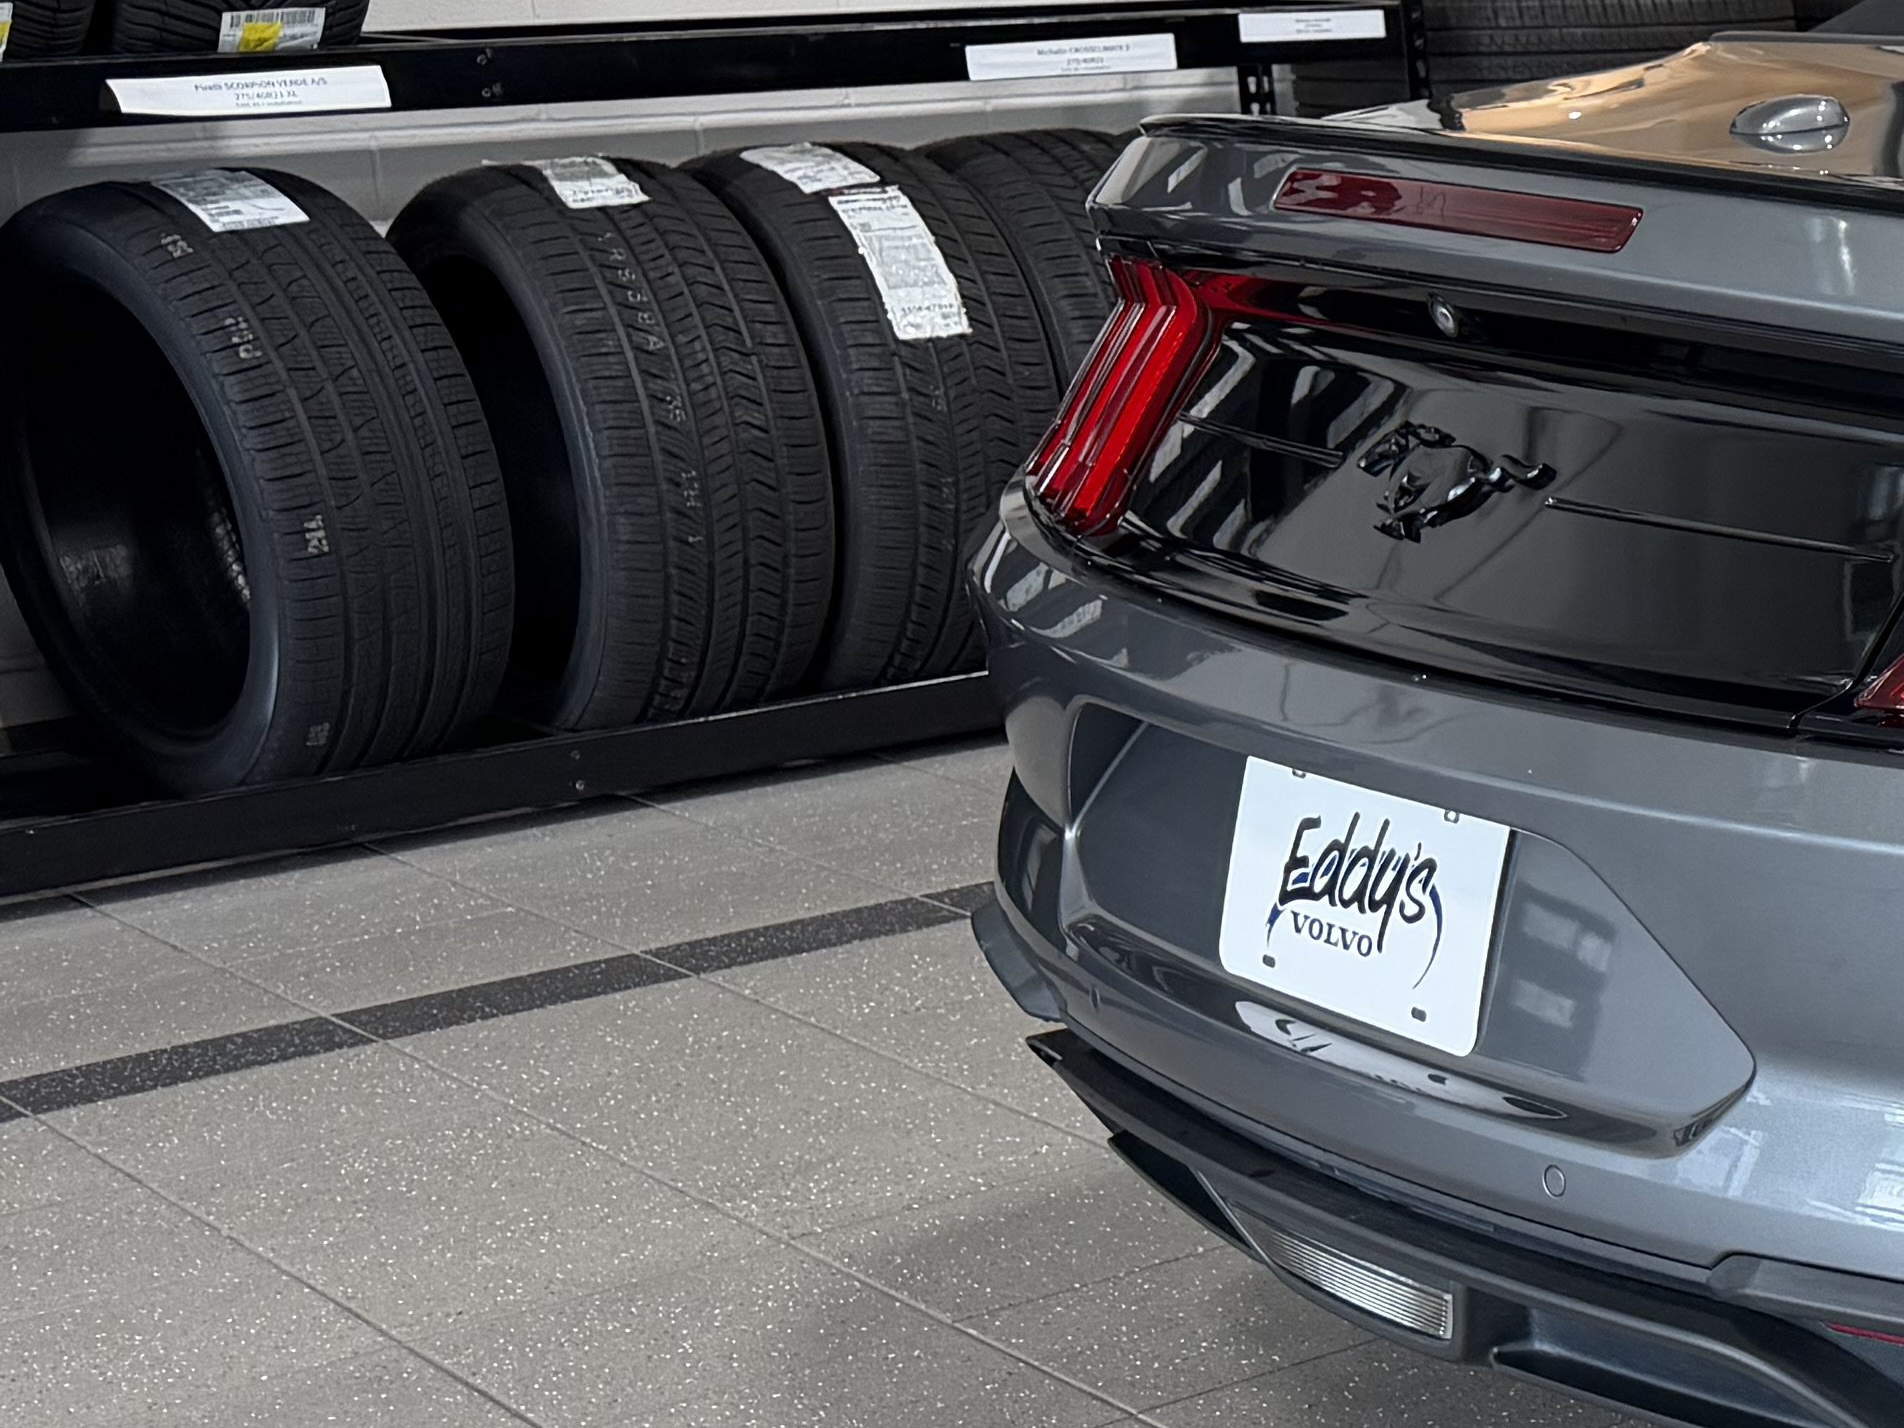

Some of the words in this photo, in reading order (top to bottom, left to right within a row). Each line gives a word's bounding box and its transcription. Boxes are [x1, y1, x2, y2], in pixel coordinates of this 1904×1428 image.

[224, 80, 275, 90] SCORPION
[1278, 811, 1438, 954] Eddy's
[1291, 910, 1373, 958] VOLVO
